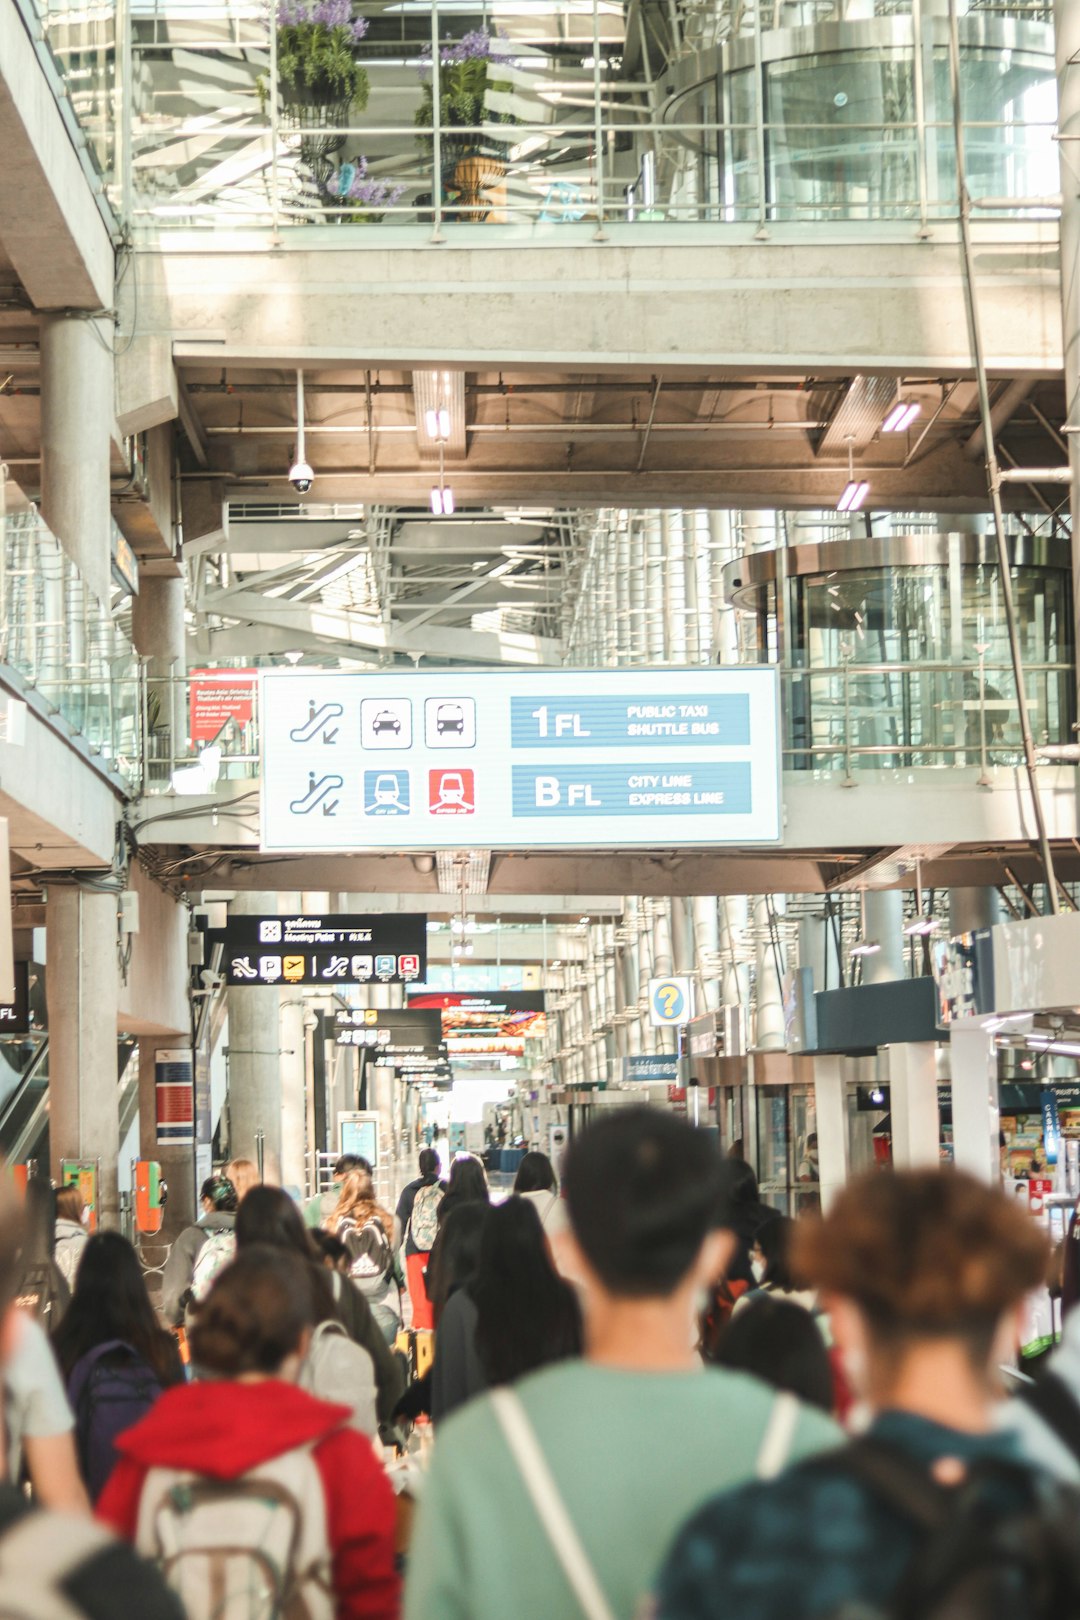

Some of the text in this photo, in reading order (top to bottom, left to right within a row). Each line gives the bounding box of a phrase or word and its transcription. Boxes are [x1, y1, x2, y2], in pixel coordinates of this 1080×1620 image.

[627, 705, 708, 718] PUBLIC TAXI
[532, 705, 591, 737] 1 FL
[627, 722, 719, 735] SHUTTLE BUS
[628, 775, 692, 788] CITY LINE
[535, 776, 601, 807] B FL
[628, 792, 724, 805] EXPRESS LINE
[284, 932, 335, 943] Meeting Point
